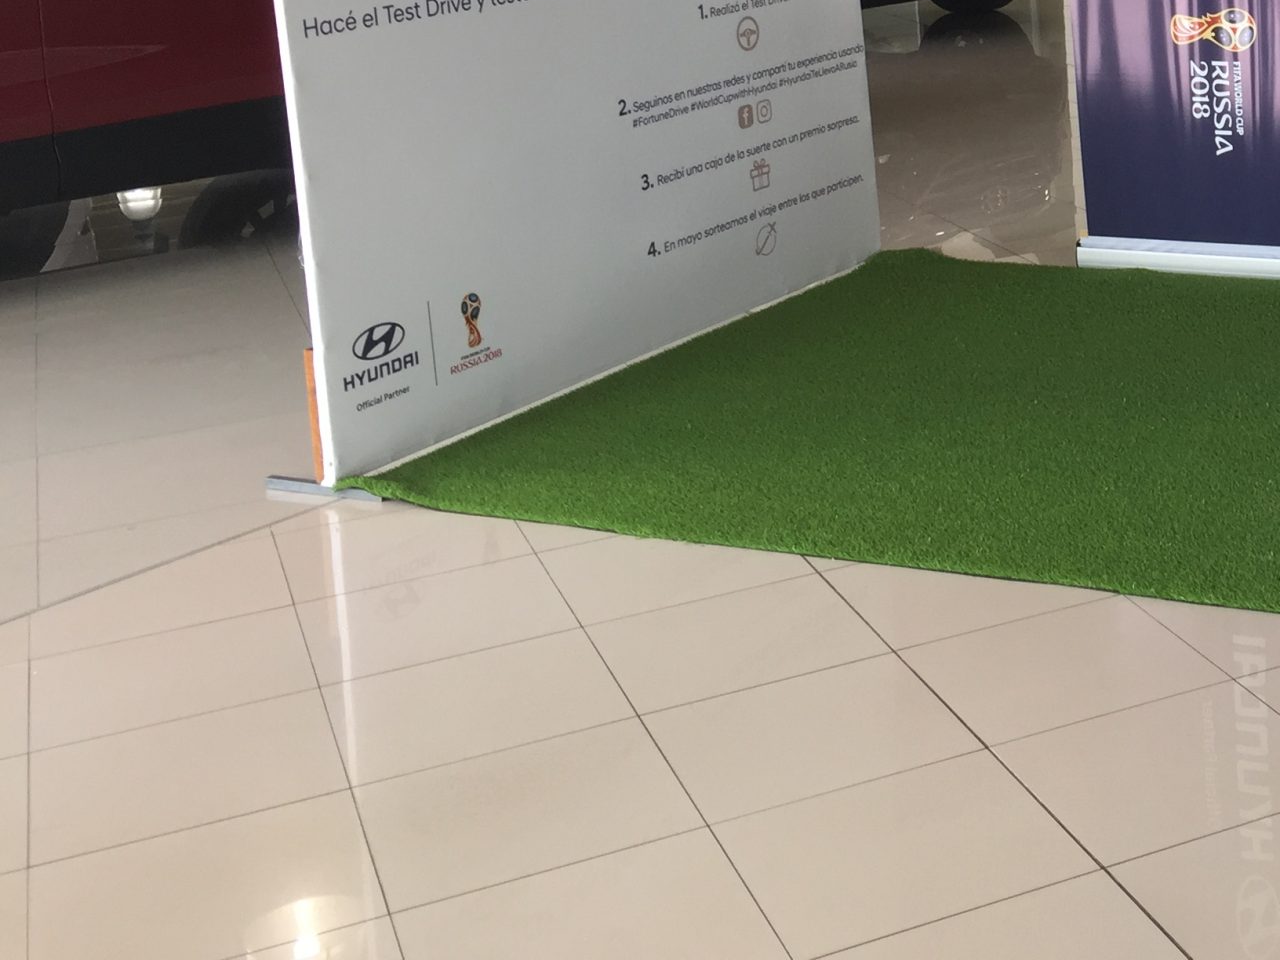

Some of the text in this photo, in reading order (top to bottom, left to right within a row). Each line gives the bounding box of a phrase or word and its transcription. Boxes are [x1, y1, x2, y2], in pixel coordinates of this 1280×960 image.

[303, 10, 357, 39] Hacé
[362, 7, 379, 30] el
[382, 2, 422, 24] Test
[698, 4, 708, 20] 1.
[710, 2, 740, 18] Realizá
[741, 0, 749, 11] el
[618, 98, 632, 117] 2.
[632, 93, 673, 113] Seguinos
[674, 90, 686, 101] en
[686, 81, 722, 99] nuestras
[723, 74, 745, 89] redes
[745, 73, 751, 84] y
[752, 63, 787, 82] compartí
[787, 62, 796, 71] tu
[797, 51, 838, 68] experiencia
[1190, 59, 1211, 119] 2018
[1211, 60, 1234, 156] RUSSIA
[1232, 61, 1245, 136] FIFA WORLD CUP
[641, 173, 654, 191] 3.
[685, 163, 703, 178] una
[704, 157, 724, 174] caja
[724, 151, 736, 165] de
[736, 150, 744, 161] la
[746, 141, 772, 157] suerte
[772, 138, 788, 149] con
[788, 134, 799, 146] un
[799, 124, 826, 142] premio
[827, 114, 860, 134] sorpresa.
[647, 174, 864, 258] 4. En mayo sorteamos el viaje entre los que participen.
[343, 351, 419, 392] HYUNDAI
[356, 386, 410, 412] Official Partner
